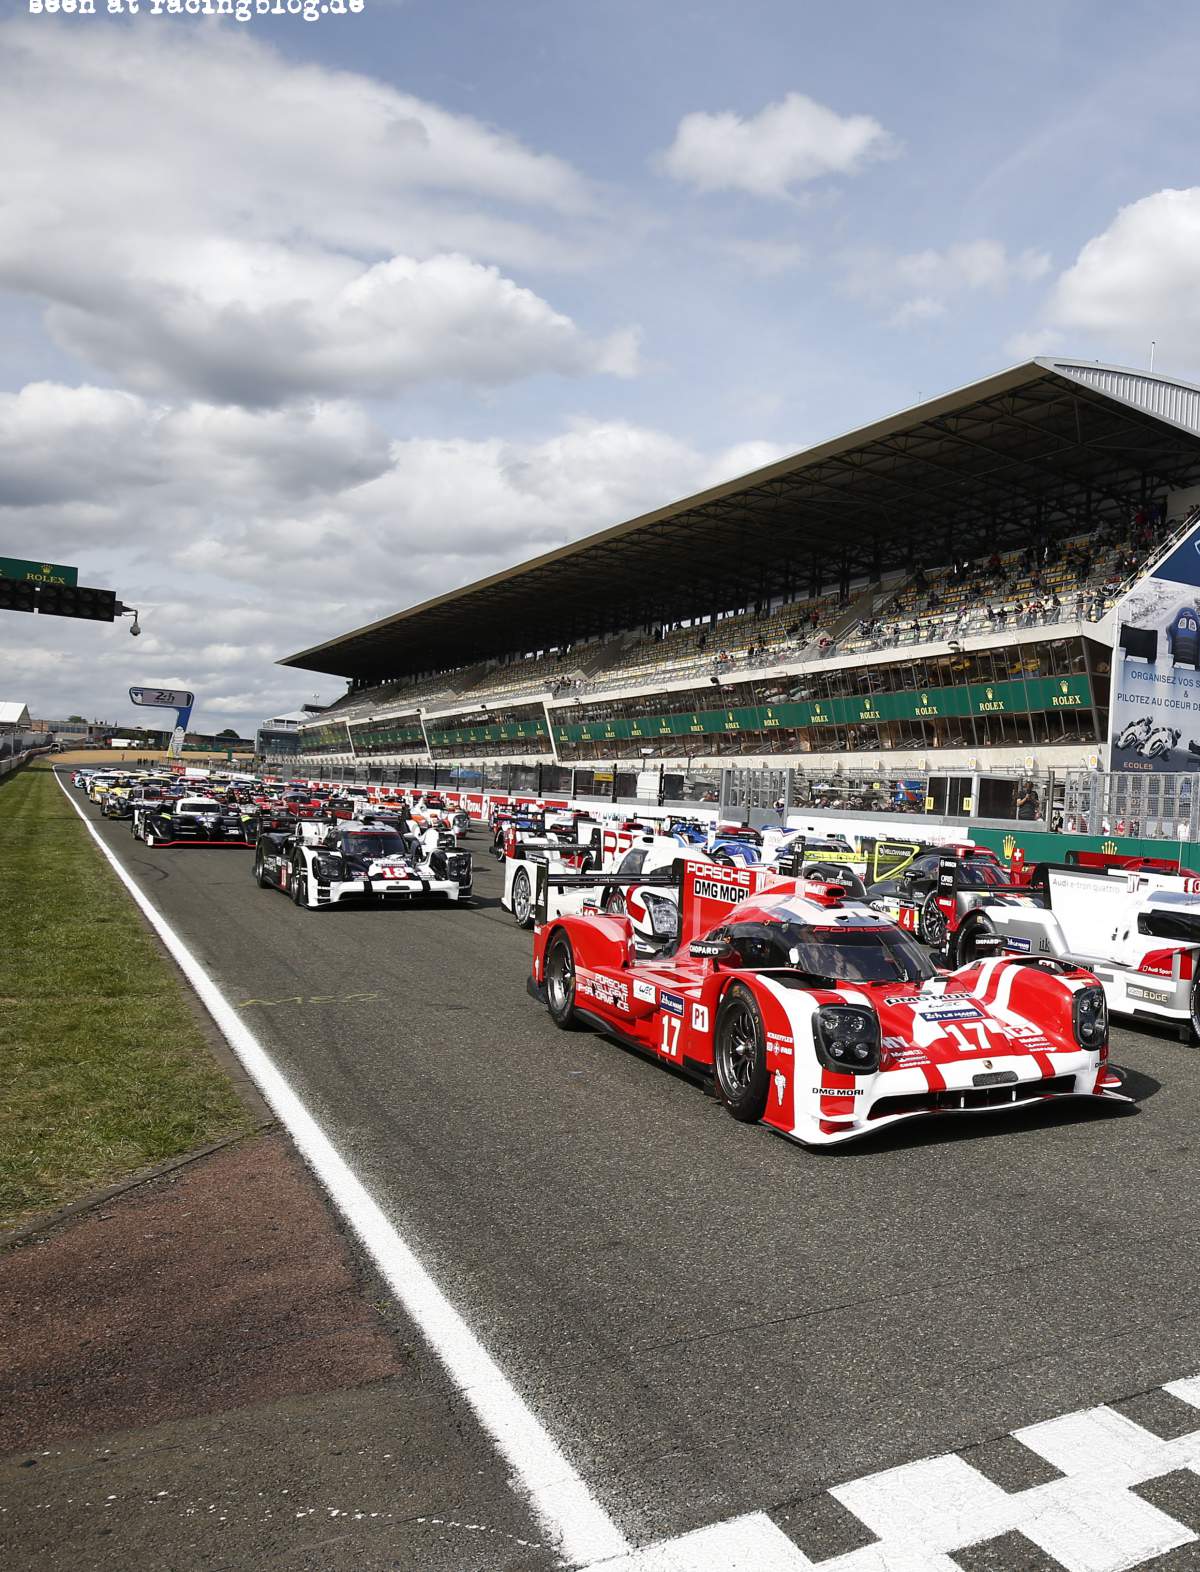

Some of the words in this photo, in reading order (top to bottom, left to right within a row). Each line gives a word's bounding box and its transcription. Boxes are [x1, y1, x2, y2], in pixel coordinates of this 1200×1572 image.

[26, 573, 65, 585] ROLEX
[1131, 670, 1176, 685] ORGANISEZ
[1178, 678, 1194, 687] VOS
[979, 701, 1004, 712] ROLEX
[1052, 695, 1081, 706] ROLEX
[1117, 693, 1150, 705] PILOTEZ
[1151, 697, 1162, 706] AU
[1164, 699, 1191, 710] COEUR
[859, 710, 881, 720] ROLEX
[915, 706, 938, 716] ROLEX
[763, 718, 780, 727] ROLEX
[811, 714, 828, 723] ROLEX
[383, 866, 409, 879] 18
[687, 862, 750, 885] PORSCHE
[695, 880, 718, 898] DMG
[1053, 879, 1068, 888] Audi
[903, 909, 910, 928] 4
[594, 973, 628, 993] PORSCHE
[1144, 991, 1168, 1002] EDGE
[694, 1007, 705, 1028] P1
[661, 1015, 681, 1056] 17
[1012, 1026, 1036, 1034] P1
[944, 1022, 992, 1051] 17
[812, 1087, 835, 1096] DMG
